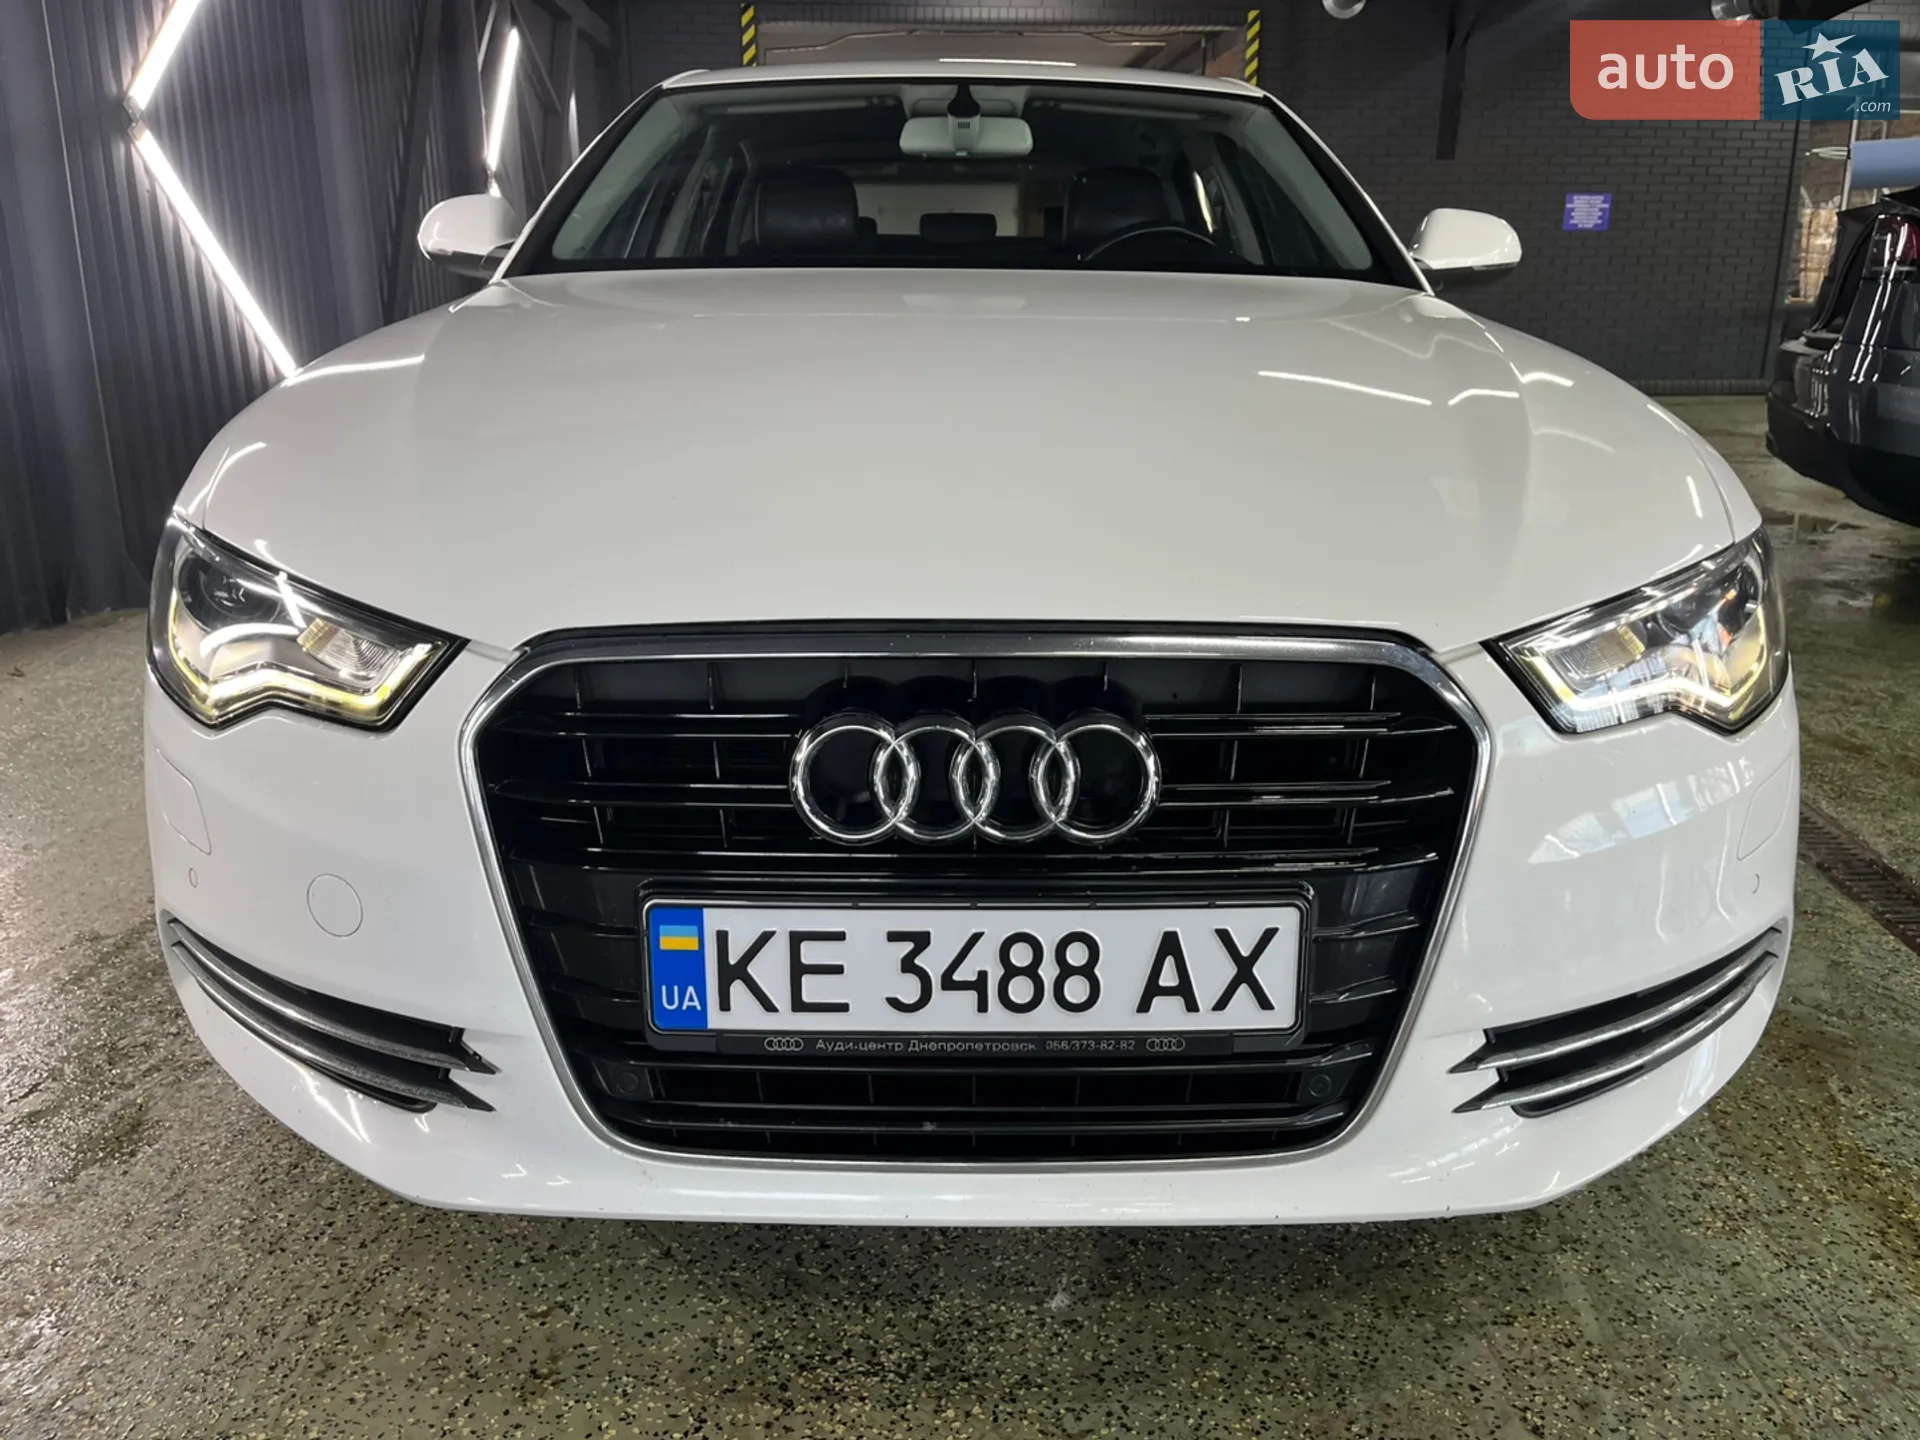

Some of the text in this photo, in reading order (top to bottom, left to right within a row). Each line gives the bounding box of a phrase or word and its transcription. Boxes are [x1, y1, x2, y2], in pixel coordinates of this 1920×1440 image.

[715, 926, 1281, 1014] KE 3488 AX
[660, 985, 702, 1011] UA
[908, 1039, 1037, 1052] Днепропетровск
